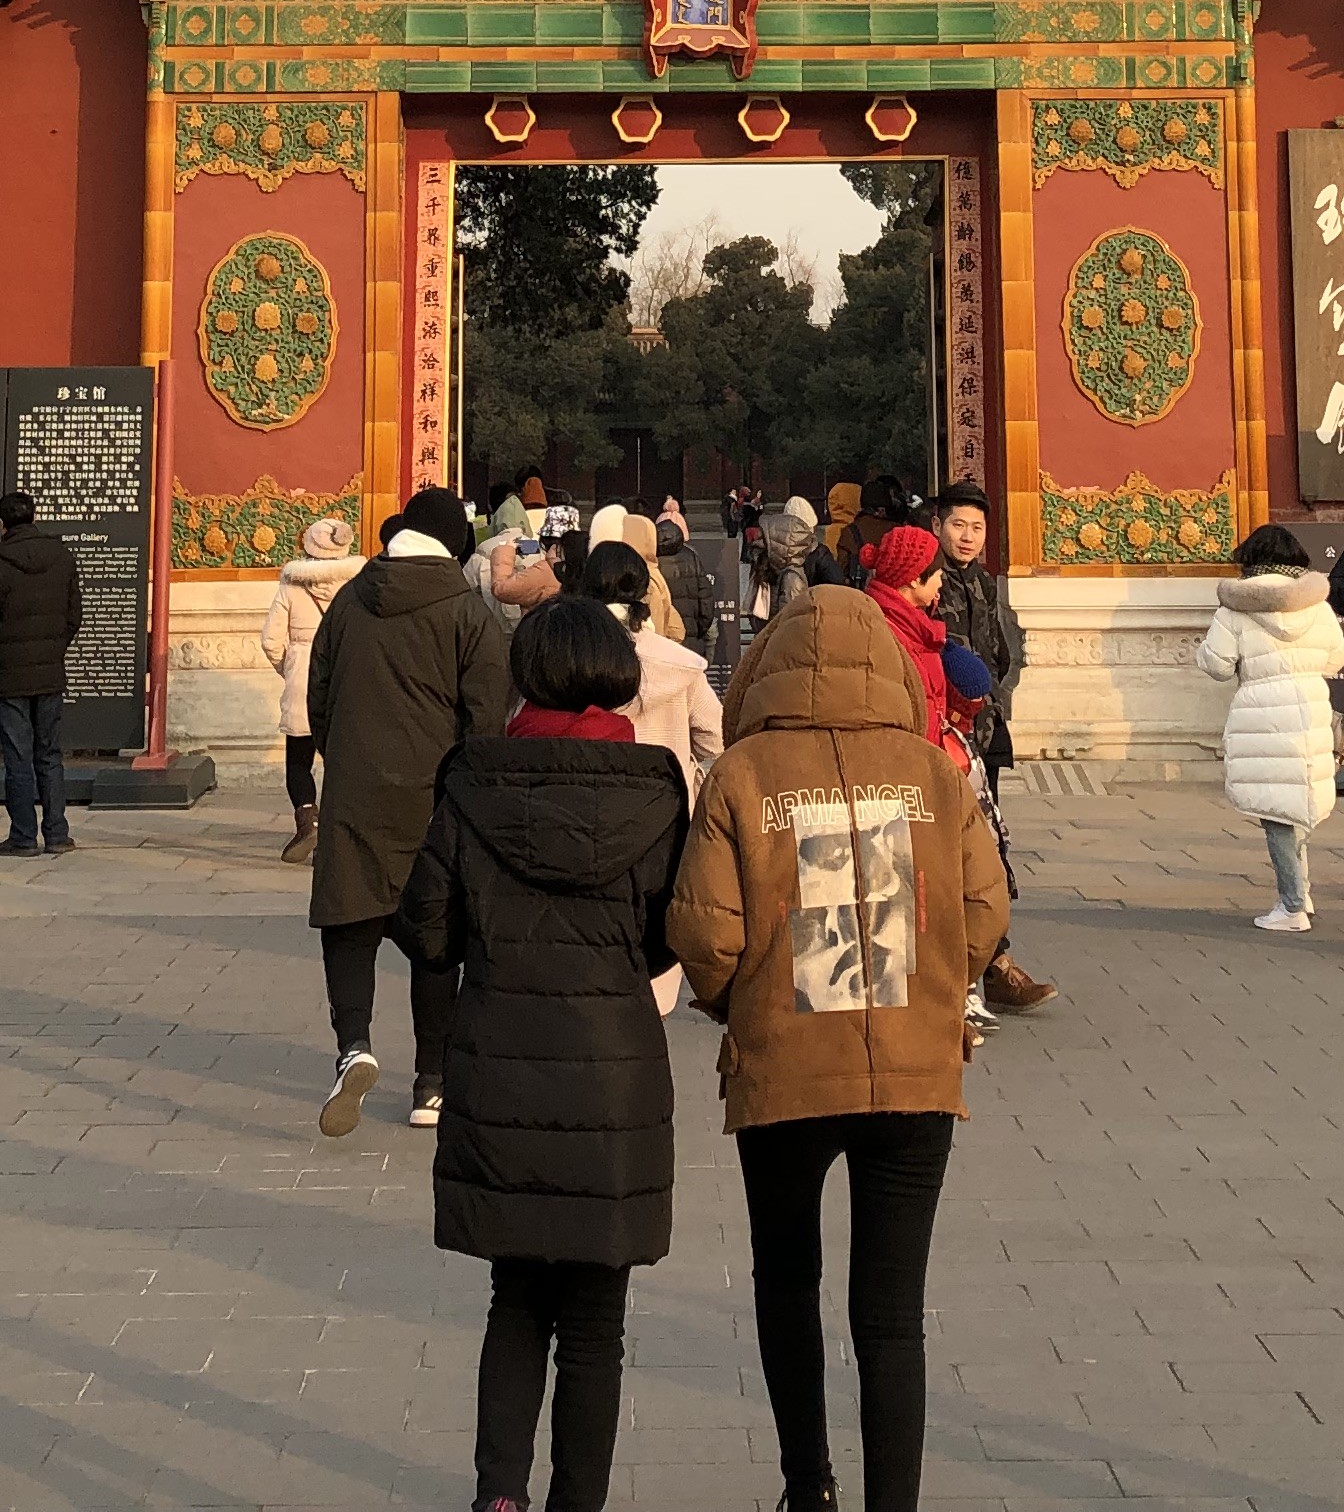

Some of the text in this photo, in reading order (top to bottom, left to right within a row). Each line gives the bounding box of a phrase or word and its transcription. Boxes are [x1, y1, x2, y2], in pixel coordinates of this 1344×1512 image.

[57, 386, 106, 400] 珍宝馆
[80, 533, 109, 543] Gallery
